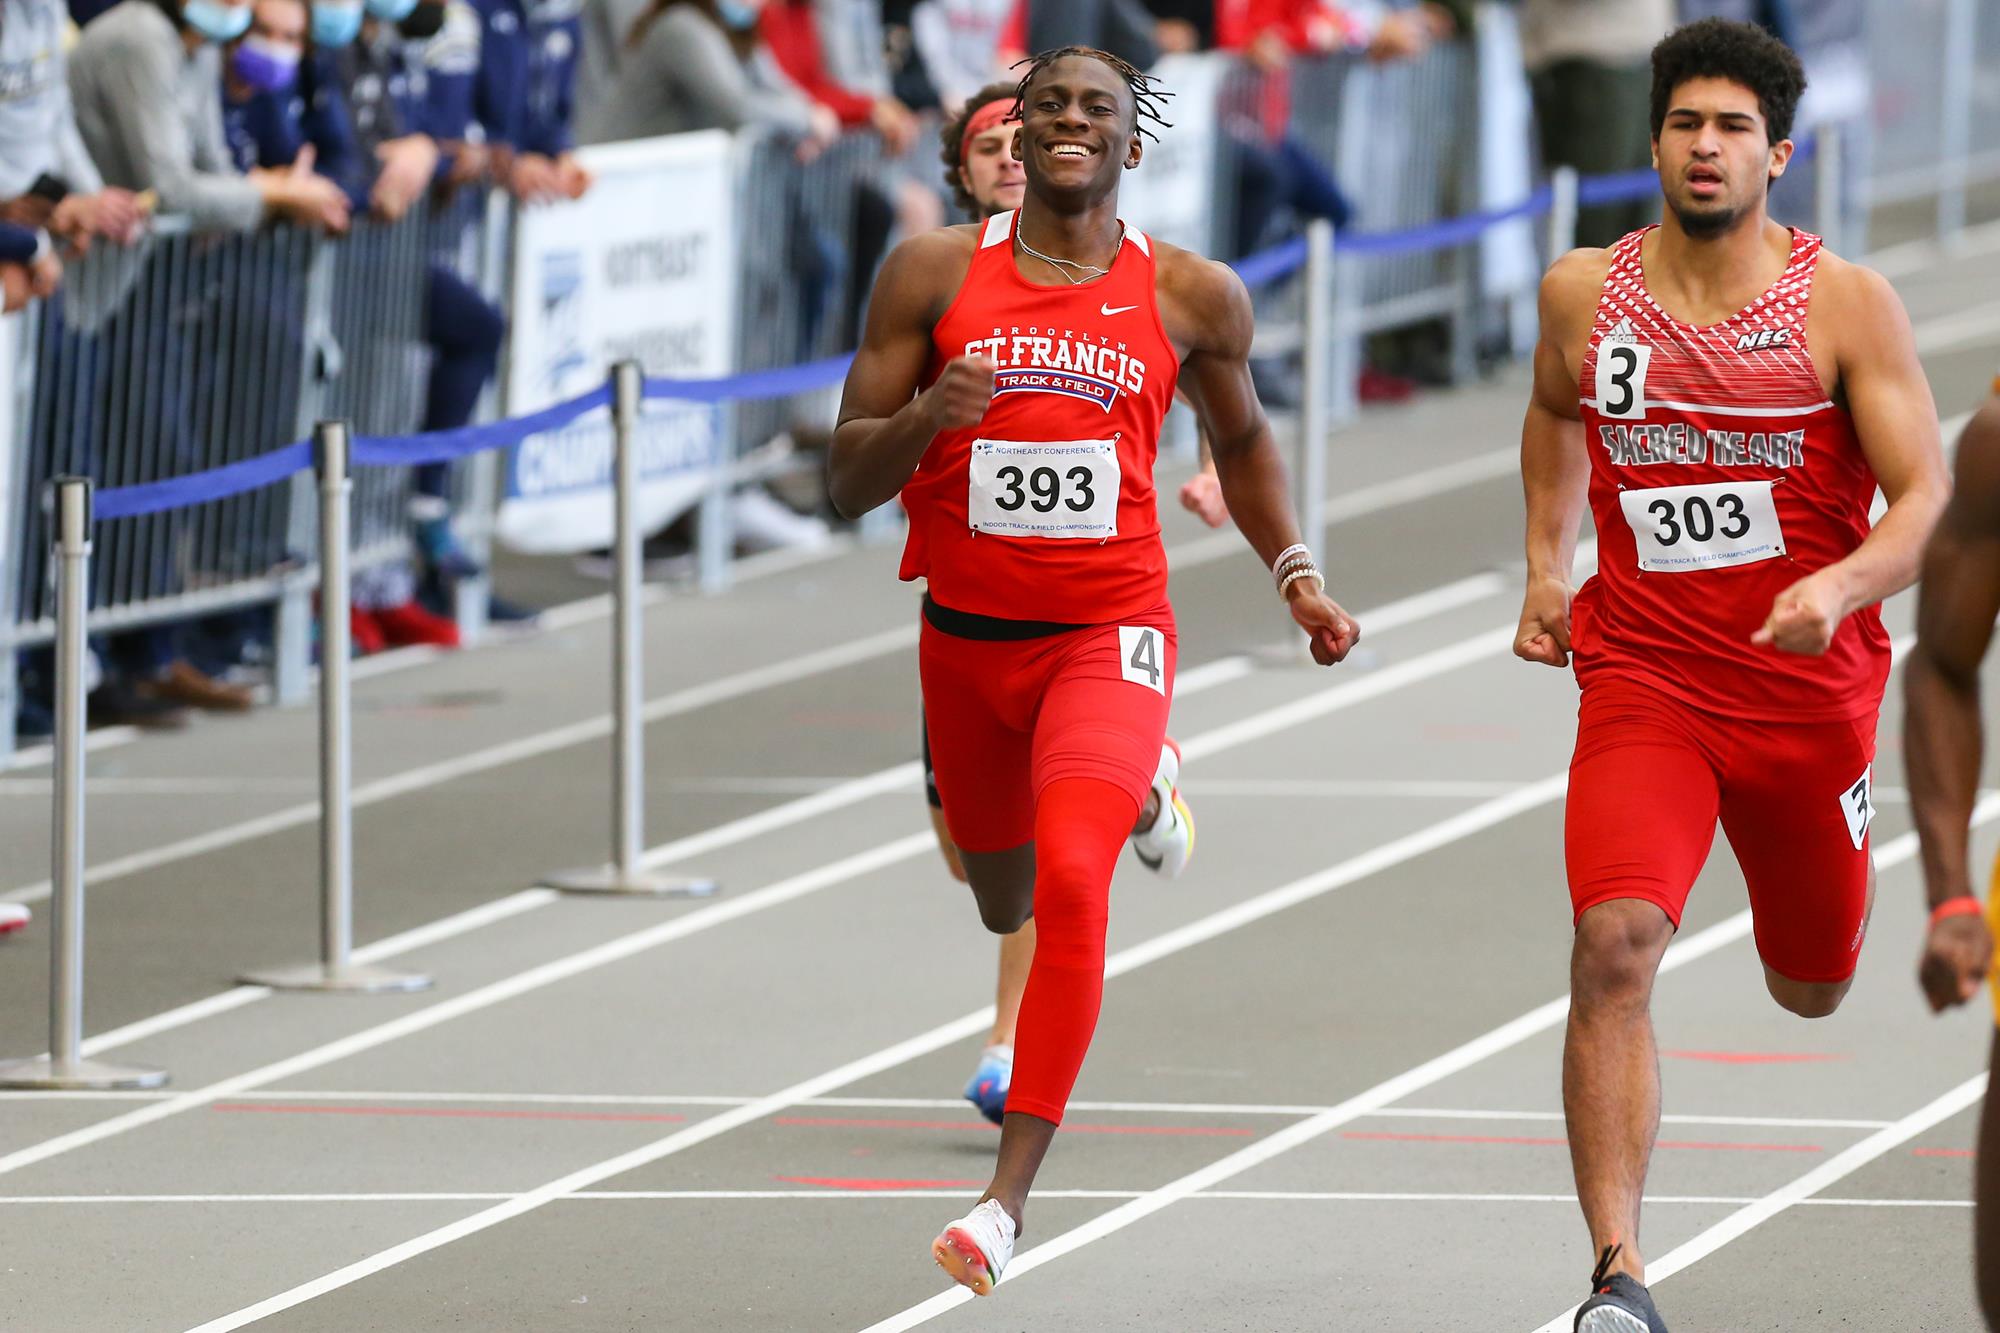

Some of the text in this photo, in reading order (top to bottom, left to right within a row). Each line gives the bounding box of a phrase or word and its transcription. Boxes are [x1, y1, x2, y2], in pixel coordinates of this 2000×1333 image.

[993, 327, 1126, 351] BROOKLYN
[1603, 333, 1638, 343] adidas
[1735, 328, 1791, 350] NEC
[1000, 375, 1105, 398] TRACK & FIELD
[1606, 347, 1638, 415] 3
[996, 446, 1096, 455] NORTHEAST CONFERENCE
[1599, 423, 1805, 469] SACRED HEART
[995, 465, 1095, 513] 393
[1648, 493, 1751, 546] 303
[1671, 557, 1691, 565] TRACK
[1131, 629, 1159, 685] 4
[1851, 778, 1867, 838] 3
